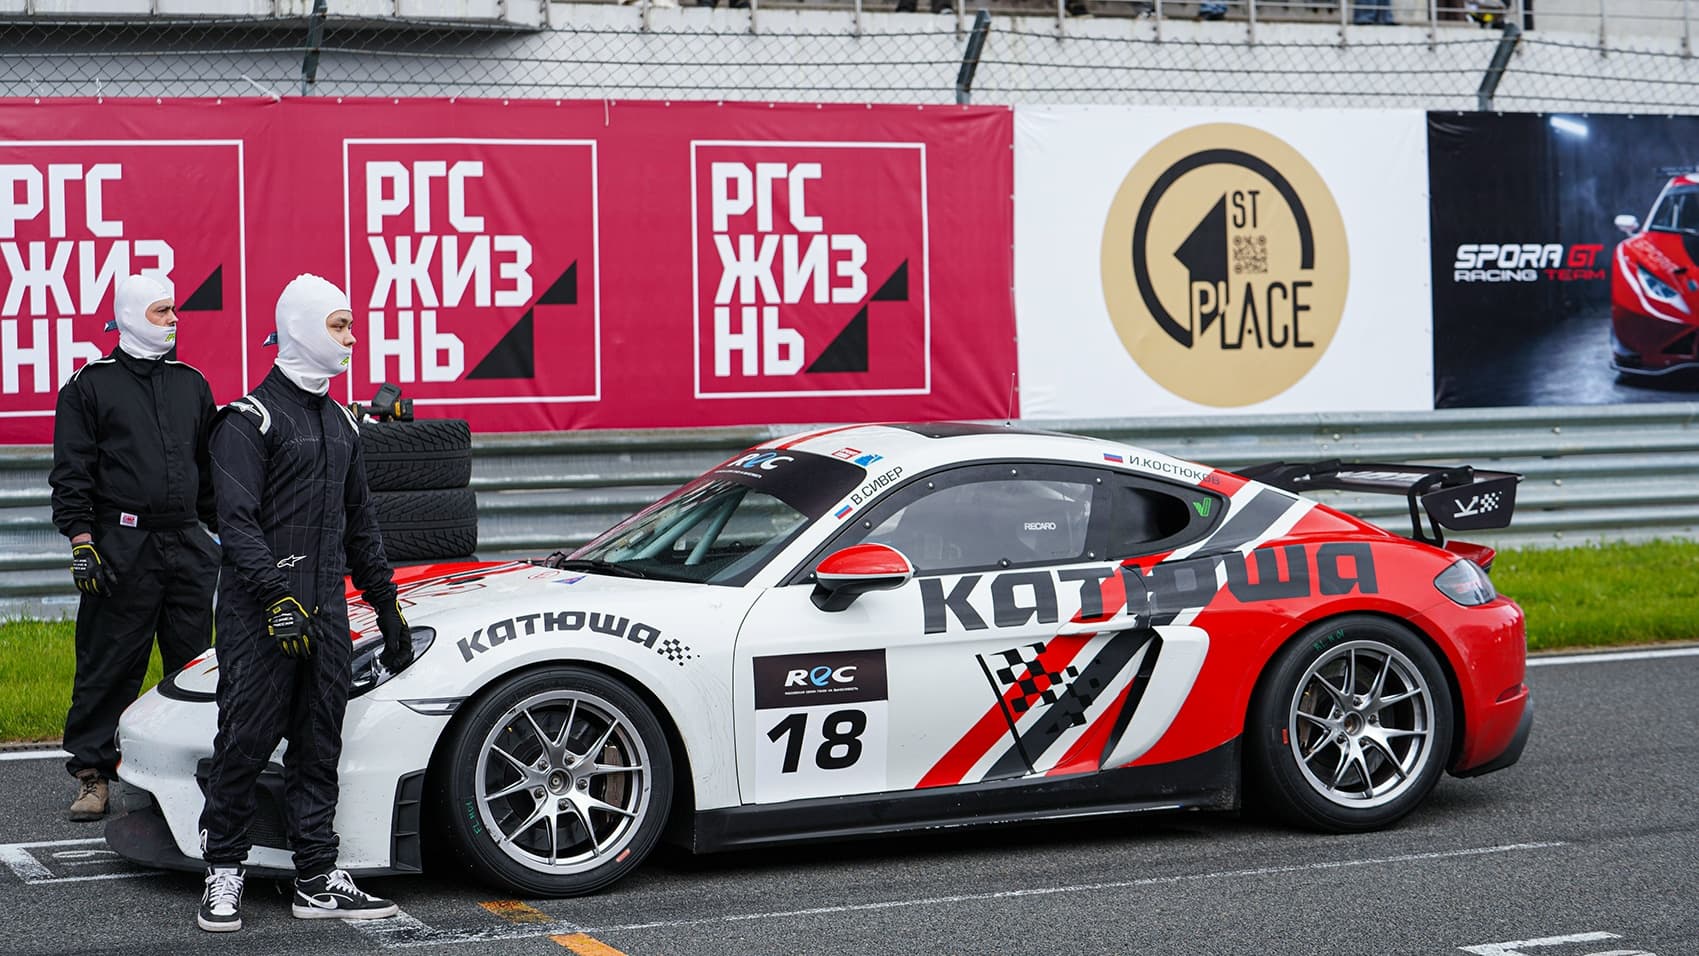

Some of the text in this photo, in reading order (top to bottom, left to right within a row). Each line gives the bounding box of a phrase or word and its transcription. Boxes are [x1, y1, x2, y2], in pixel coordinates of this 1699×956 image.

[0, 163, 124, 238] РГС
[366, 160, 485, 233] РГС
[711, 162, 823, 232] РГС
[368, 234, 533, 309] ЖИЗ
[713, 233, 868, 304] ЖИЗ
[1454, 243, 1605, 269] SPORA GT
[1454, 269, 1606, 283] RACING TEAM
[369, 309, 465, 384] НЬ
[714, 306, 805, 377] НЬ
[1191, 280, 1315, 350] PLACE
[850, 465, 904, 506] В.СИВЕР
[1129, 455, 1220, 486] И.КОСТЮКОВ
[1024, 522, 1057, 531] RECARO
[766, 709, 868, 774] 18
